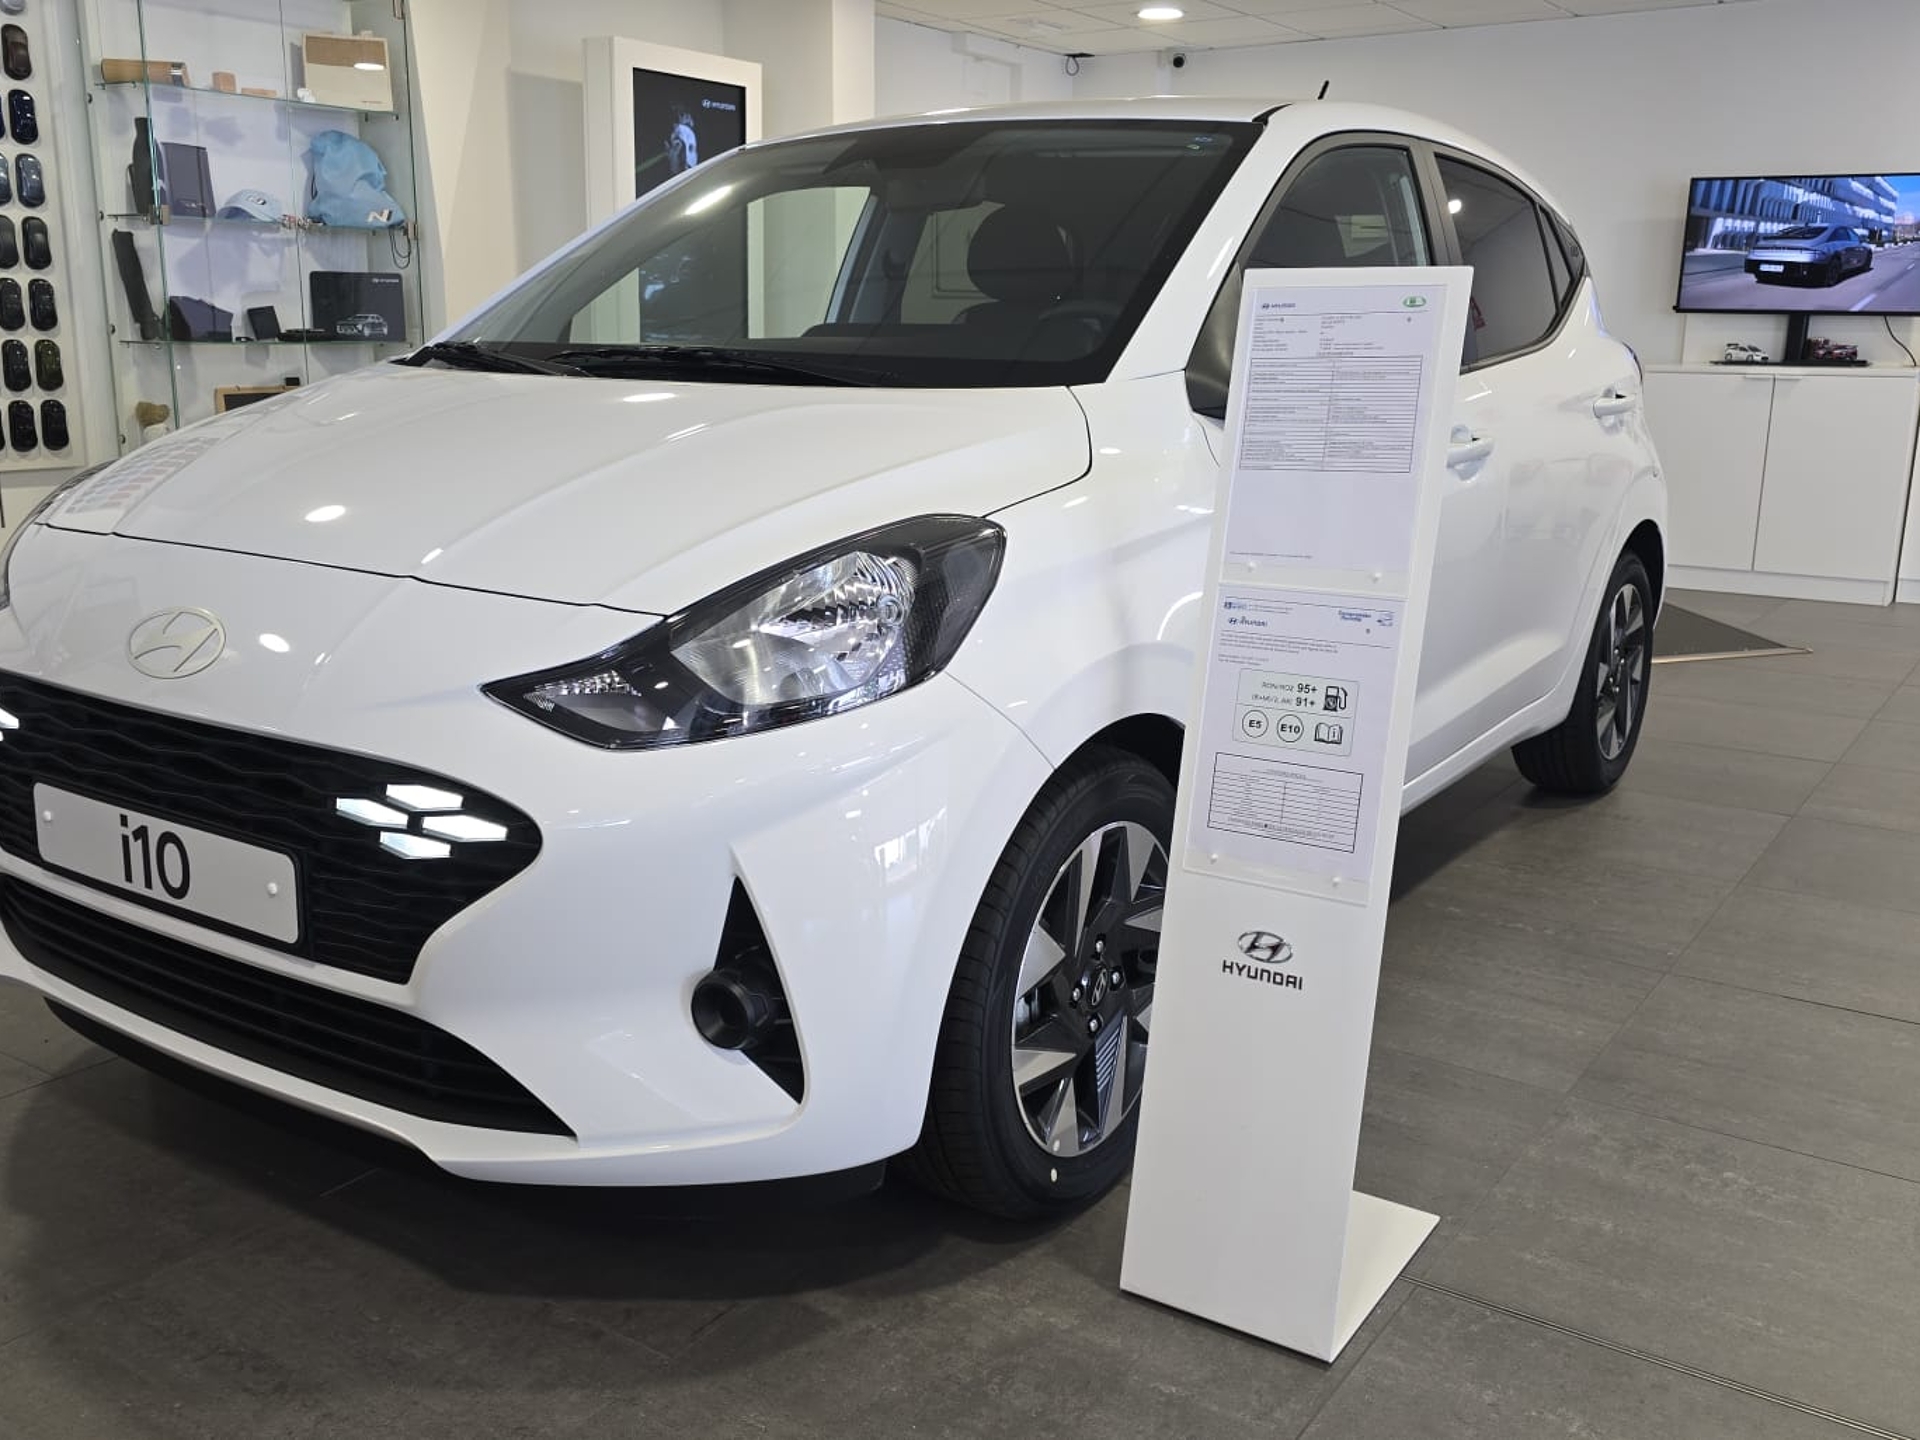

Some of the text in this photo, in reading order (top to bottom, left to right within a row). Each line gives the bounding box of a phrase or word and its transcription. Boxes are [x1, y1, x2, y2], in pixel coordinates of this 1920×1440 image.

[1296, 683, 1318, 694] 95+
[1295, 697, 1315, 707] 91+
[1249, 720, 1263, 729] E5
[1280, 723, 1301, 734] E10
[119, 814, 191, 900] i10
[1222, 959, 1303, 991] HYUNDAI
